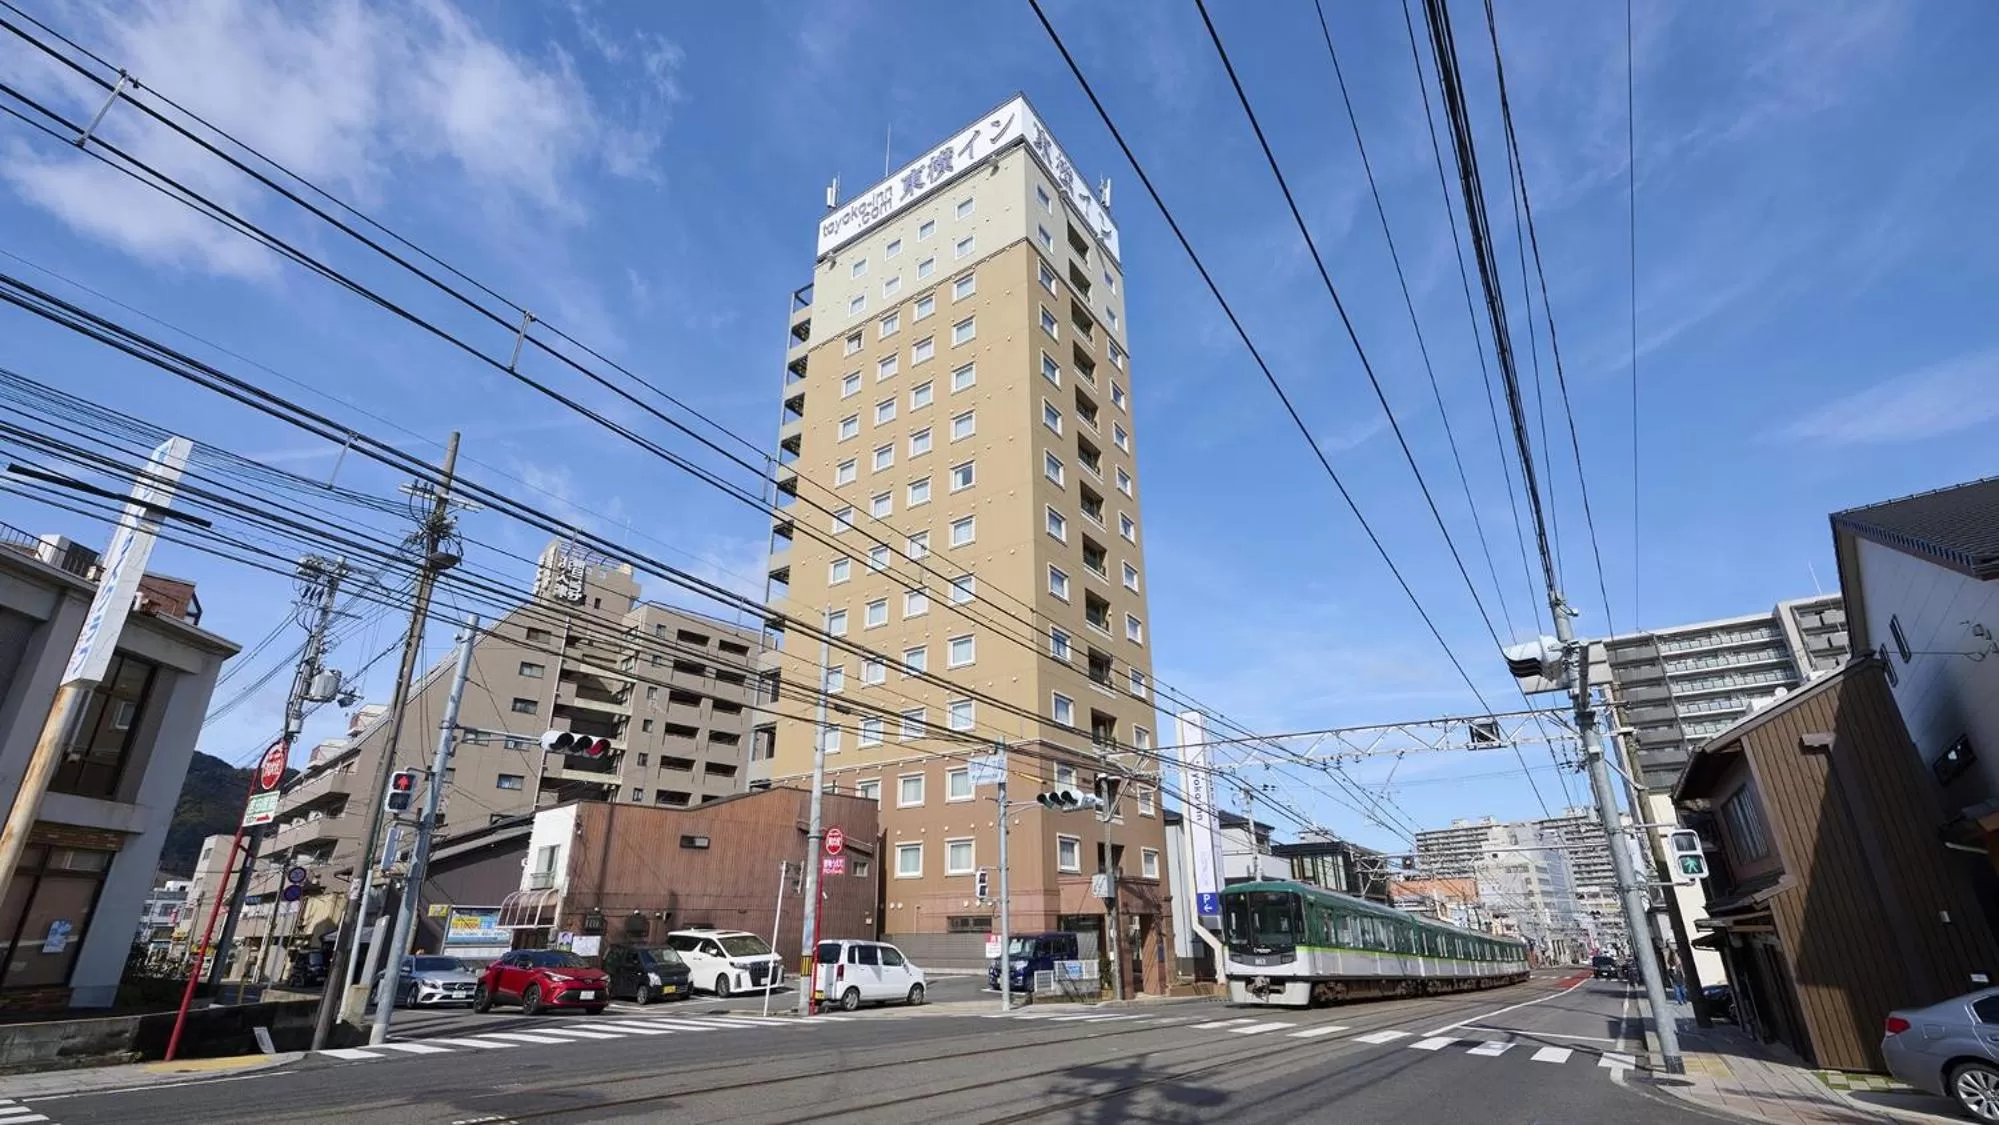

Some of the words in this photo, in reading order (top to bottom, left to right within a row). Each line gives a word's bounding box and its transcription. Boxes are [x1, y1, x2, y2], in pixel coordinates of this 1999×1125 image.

[901, 112, 1015, 201] 東横イン
[822, 185, 893, 237] toyoko-inn
[858, 198, 893, 229] .com
[1203, 894, 1211, 904] P
